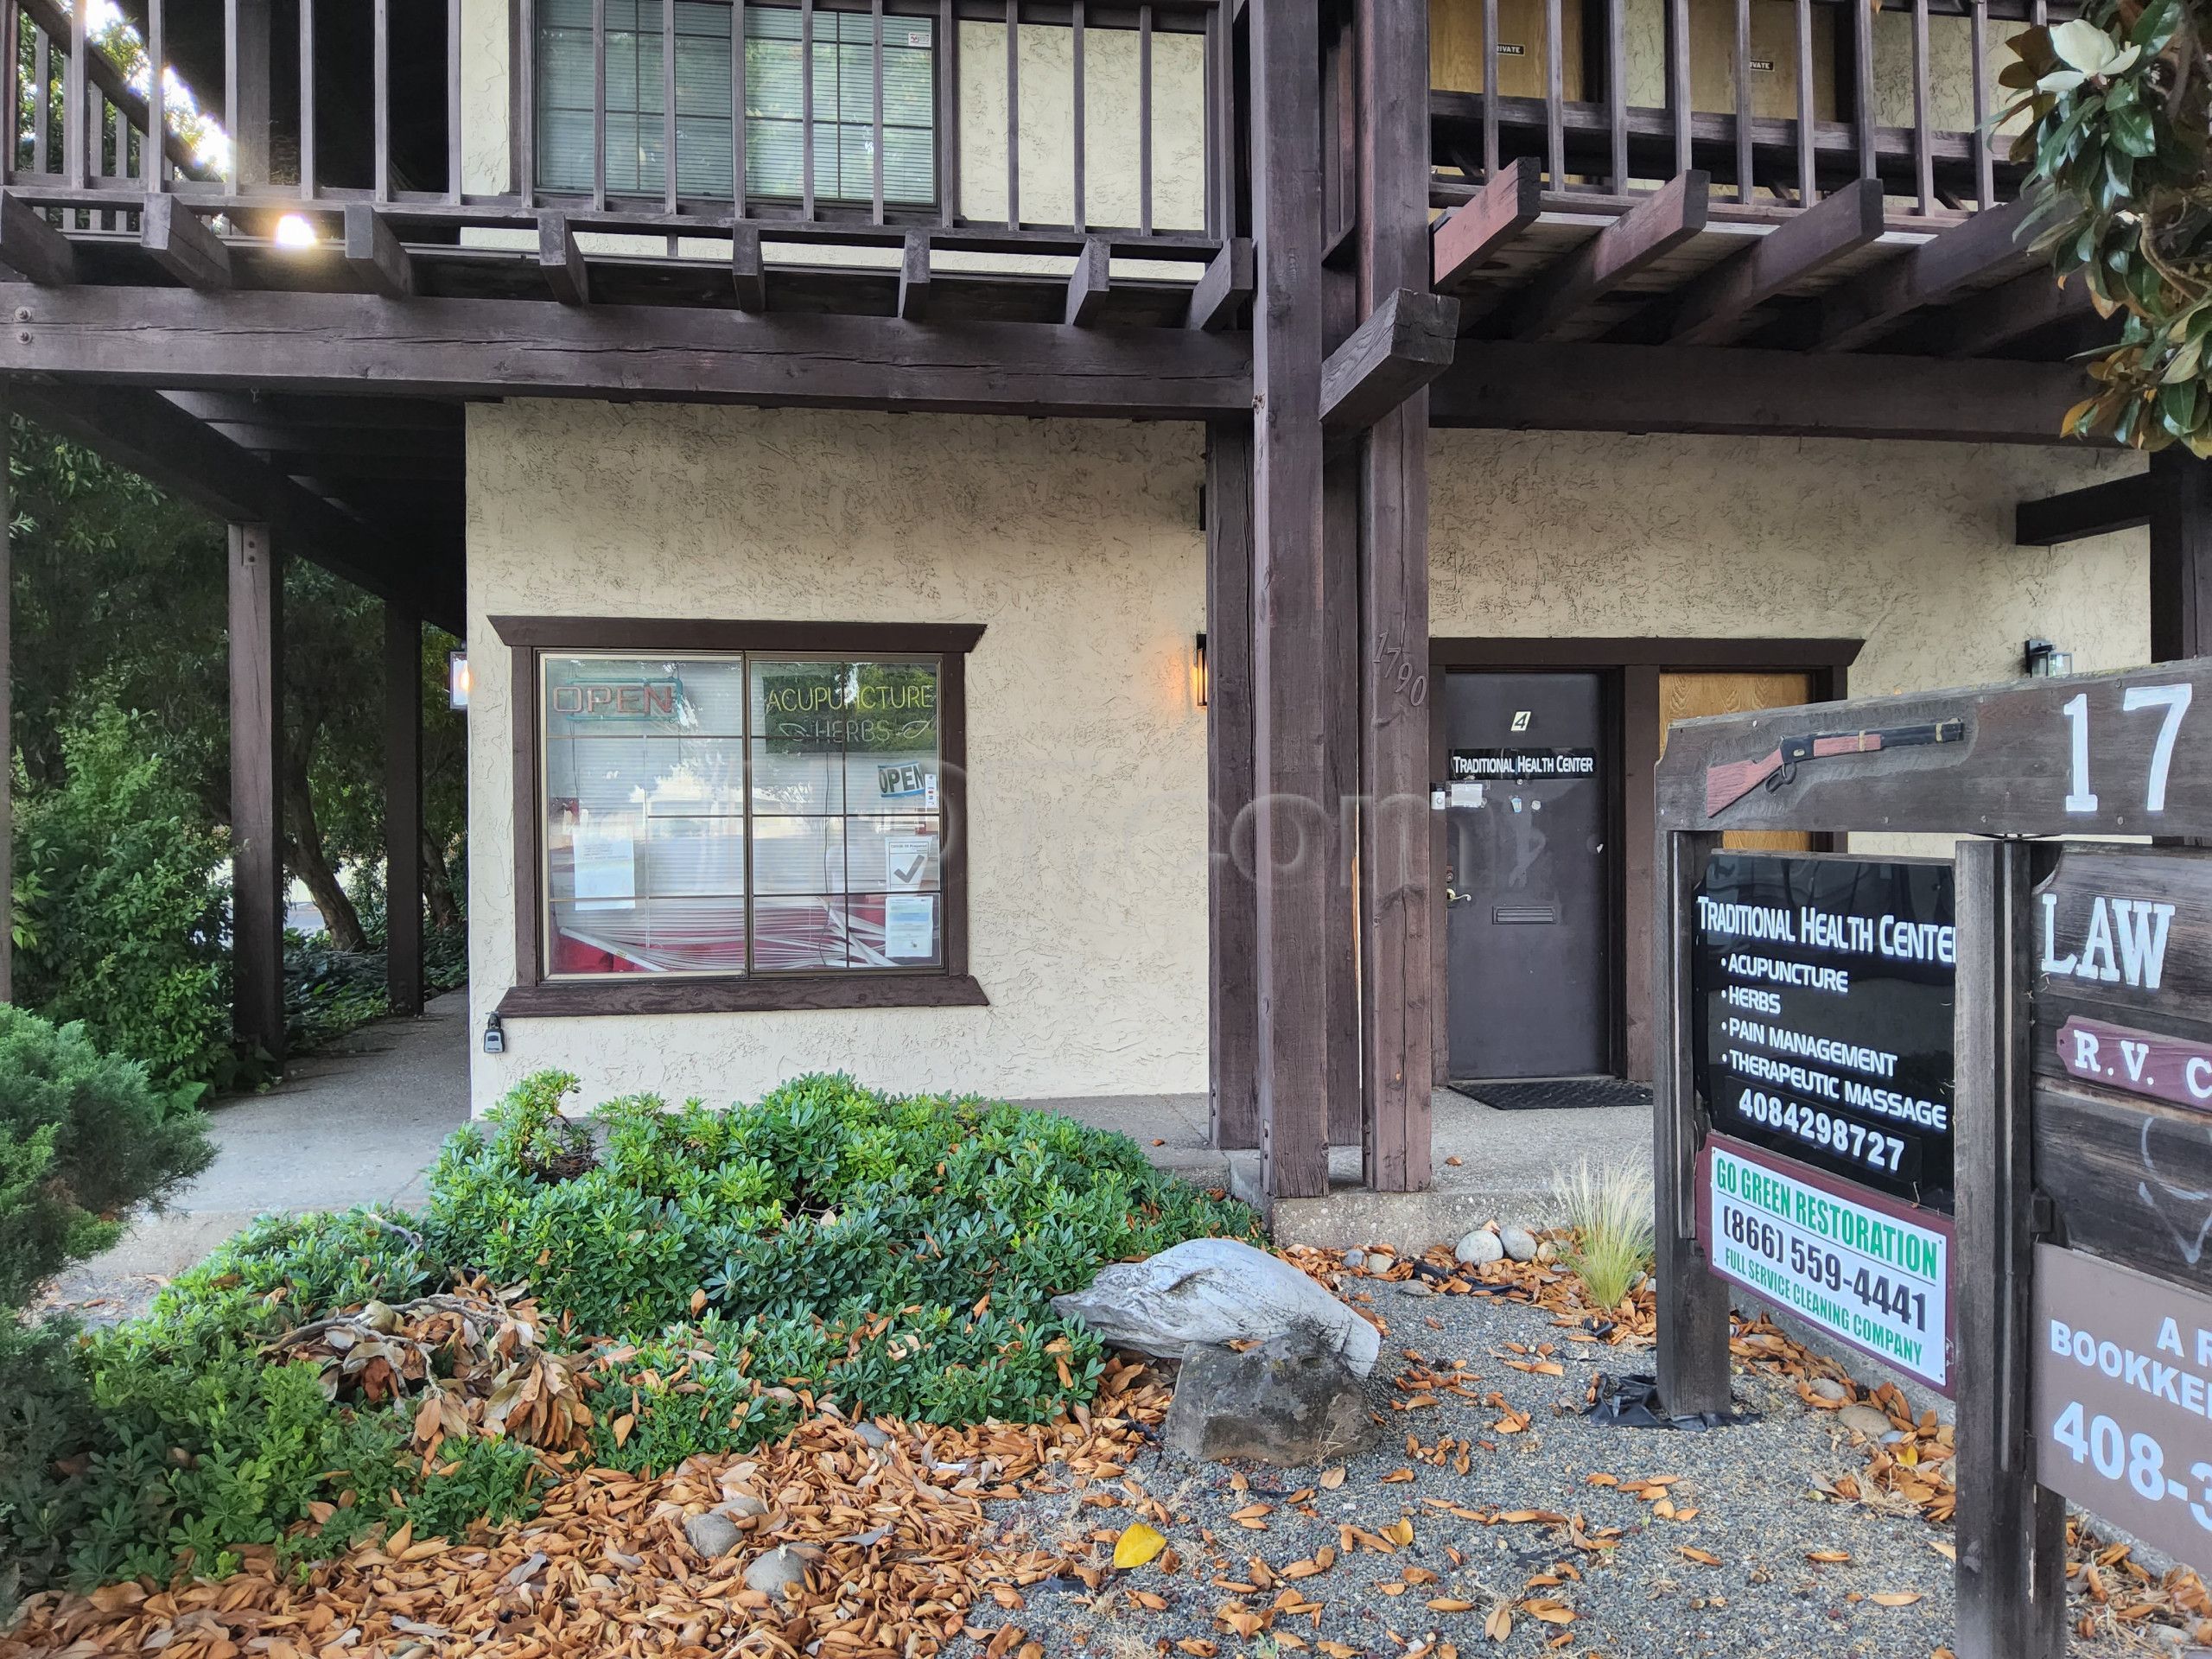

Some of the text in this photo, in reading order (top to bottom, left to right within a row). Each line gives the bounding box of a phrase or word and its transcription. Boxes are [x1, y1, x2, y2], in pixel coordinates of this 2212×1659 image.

[553, 685, 672, 713] OPEN
[1373, 632, 1427, 707] 1790
[766, 685, 934, 714] ACUPUNCTURE
[1514, 714, 1529, 729] 4
[815, 720, 891, 743] HERBS
[2063, 683, 2193, 812] 17
[878, 765, 925, 794] OPEN
[1879, 915, 1955, 963] CENTE
[2041, 893, 2176, 988] LAW
[1728, 953, 1849, 993] ACUPUNCTURE
[1728, 985, 1781, 1014] HERBS
[1729, 1018, 1897, 1077] PAIN MANAGEMENT
[1729, 1049, 1947, 1129] THERAPEUTIC MASSAGE
[1738, 1088, 1904, 1172] 4084298727
[1717, 1157, 1937, 1281] GO GREEN RESTORATION
[1723, 1205, 1927, 1333] (866) 559-4441
[1726, 1247, 1923, 1366] FULL SERVICE CLEANING COMPANY
[2157, 1316, 2184, 1357] A
[2050, 1319, 2212, 1420] BOOKKE
